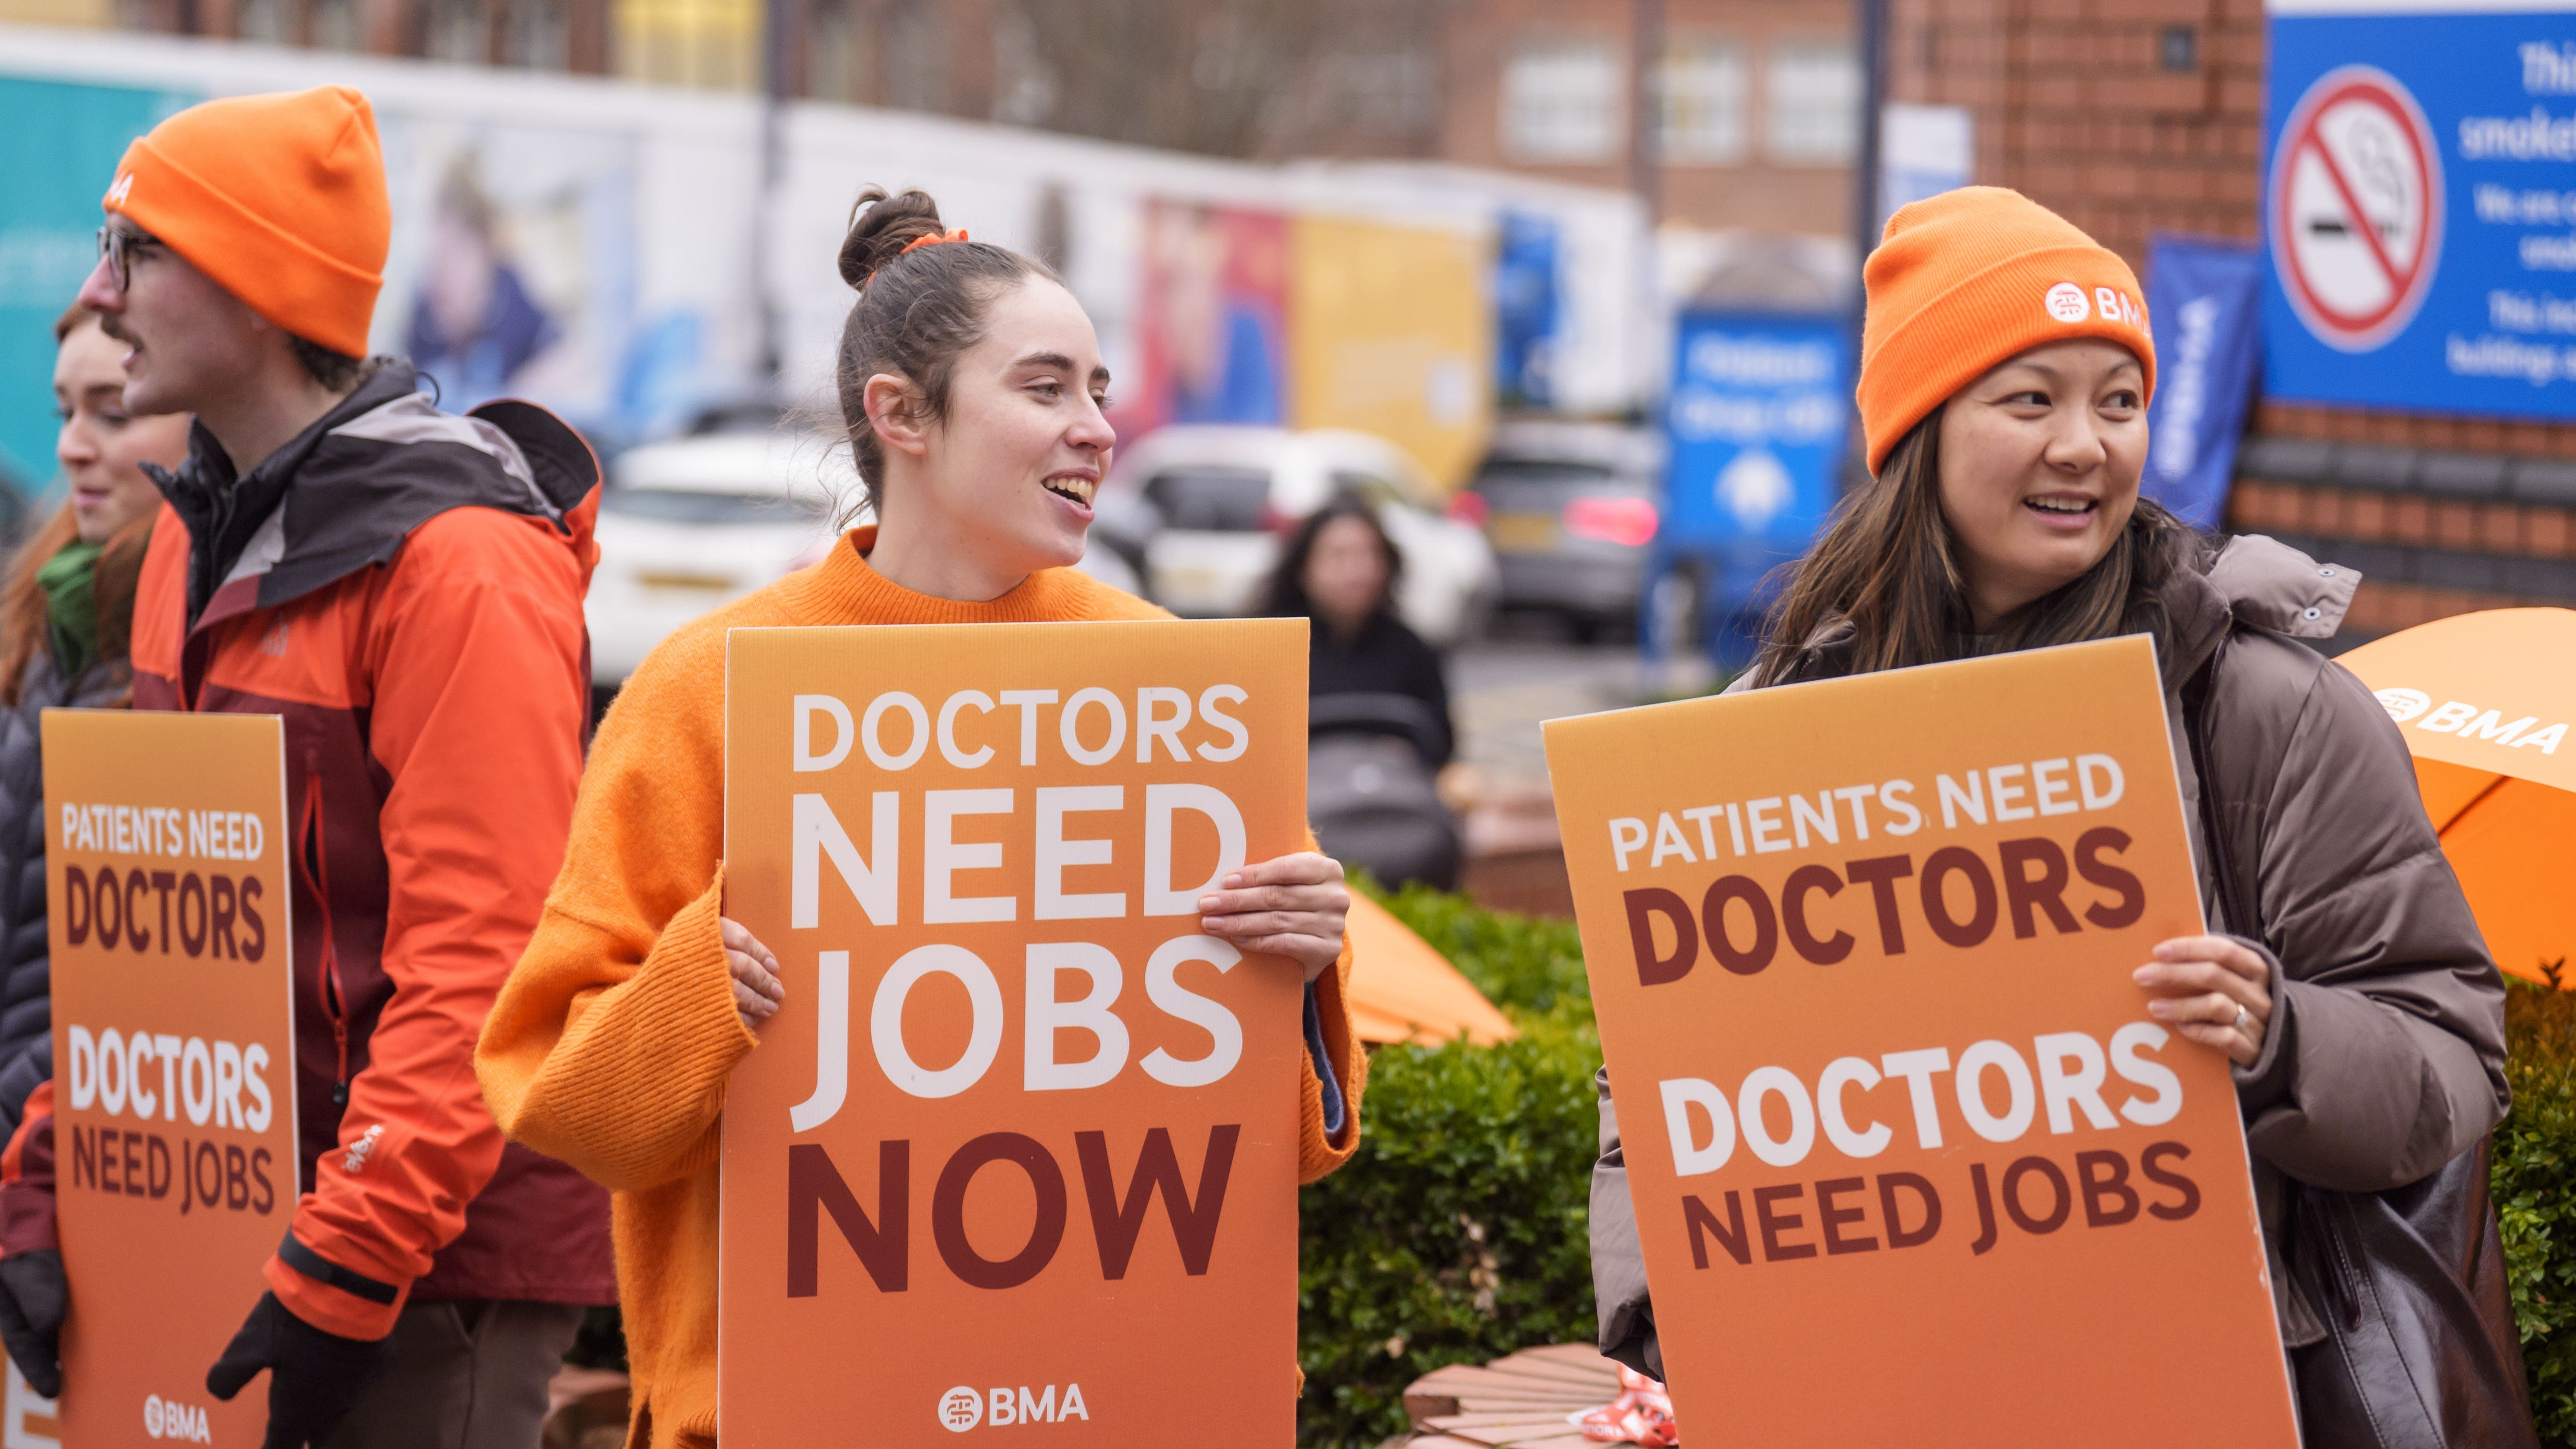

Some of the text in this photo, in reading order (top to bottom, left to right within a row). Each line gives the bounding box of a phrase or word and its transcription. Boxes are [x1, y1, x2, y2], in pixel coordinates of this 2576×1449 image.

[793, 684, 1249, 772] DOCTORS
[2416, 701, 2569, 755] BMA
[62, 802, 264, 861] PATIENTS NEED
[792, 783, 1247, 929] NEED
[1607, 753, 2126, 872] PATIENTS NEED
[65, 865, 265, 963] DOCTORS
[1623, 826, 2146, 987] DOCTORS
[69, 1025, 272, 1133] DOCTORS
[789, 935, 1243, 1133] JOBS
[1658, 1021, 2183, 1177] DOCTORS
[72, 1124, 274, 1216] NEED JOBS
[787, 1124, 1241, 1298] NOW
[1681, 1140, 2201, 1271] NEED JOBS
[165, 1401, 211, 1444] BMA
[989, 1383, 1089, 1426] BMA
